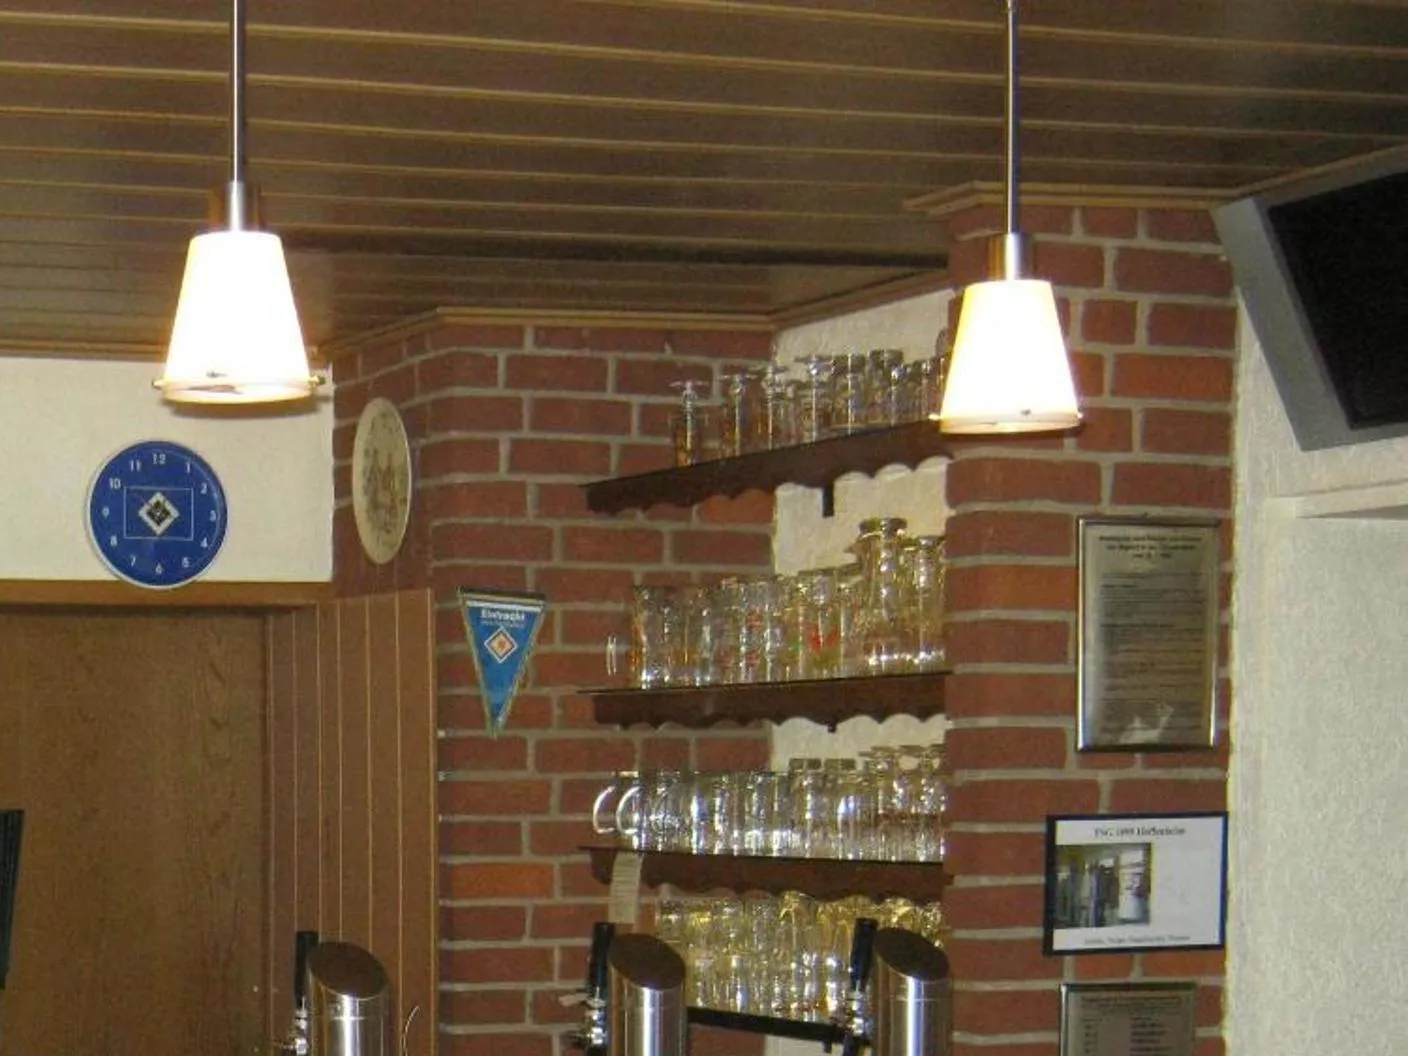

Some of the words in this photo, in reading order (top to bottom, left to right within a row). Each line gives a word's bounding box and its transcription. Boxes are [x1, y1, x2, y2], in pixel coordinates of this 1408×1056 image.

[153, 453, 166, 465] 12
[130, 459, 141, 472] 11
[109, 477, 121, 489] 10
[200, 482, 208, 495] 2
